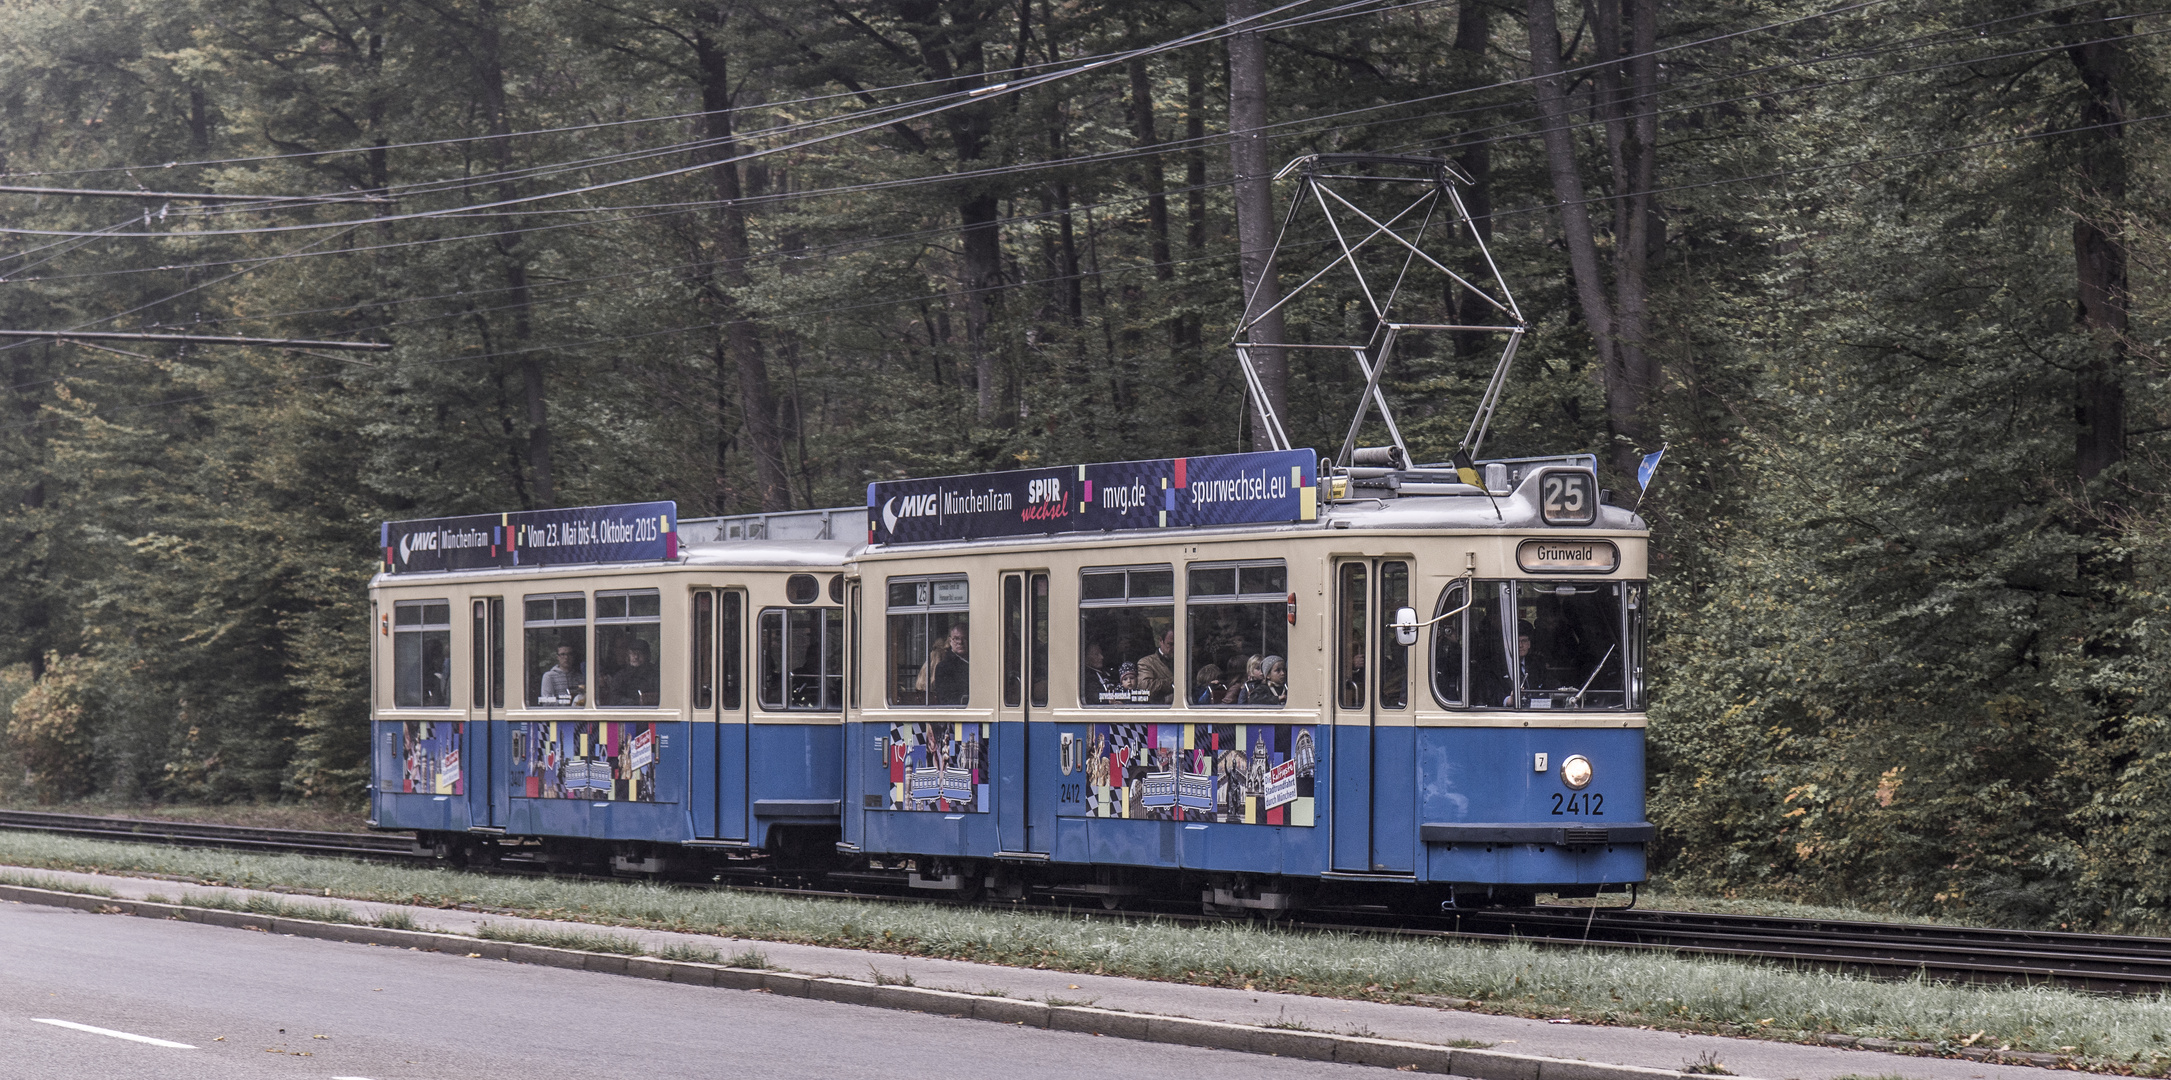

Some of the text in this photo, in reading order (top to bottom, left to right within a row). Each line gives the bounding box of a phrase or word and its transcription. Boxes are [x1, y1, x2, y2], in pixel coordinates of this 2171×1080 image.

[944, 488, 1012, 515] MünchenTram
[1028, 477, 1061, 504] SPUR
[1103, 476, 1146, 515] mvg.de
[1191, 468, 1287, 511] spurwechsel.eu
[1545, 477, 1584, 512] 25
[897, 494, 937, 518] MVG
[1021, 490, 1069, 523] wechsel
[410, 531, 437, 552] MVG
[441, 528, 488, 550] MünchenTram
[527, 517, 657, 548] Vom 23. Mai bis 4. Oktober 2015
[1537, 545, 1593, 561] Grünwald
[918, 584, 927, 603] 25
[1539, 757, 1544, 767] 7
[1061, 783, 1080, 803] 2412
[1551, 793, 1604, 816] 2412
